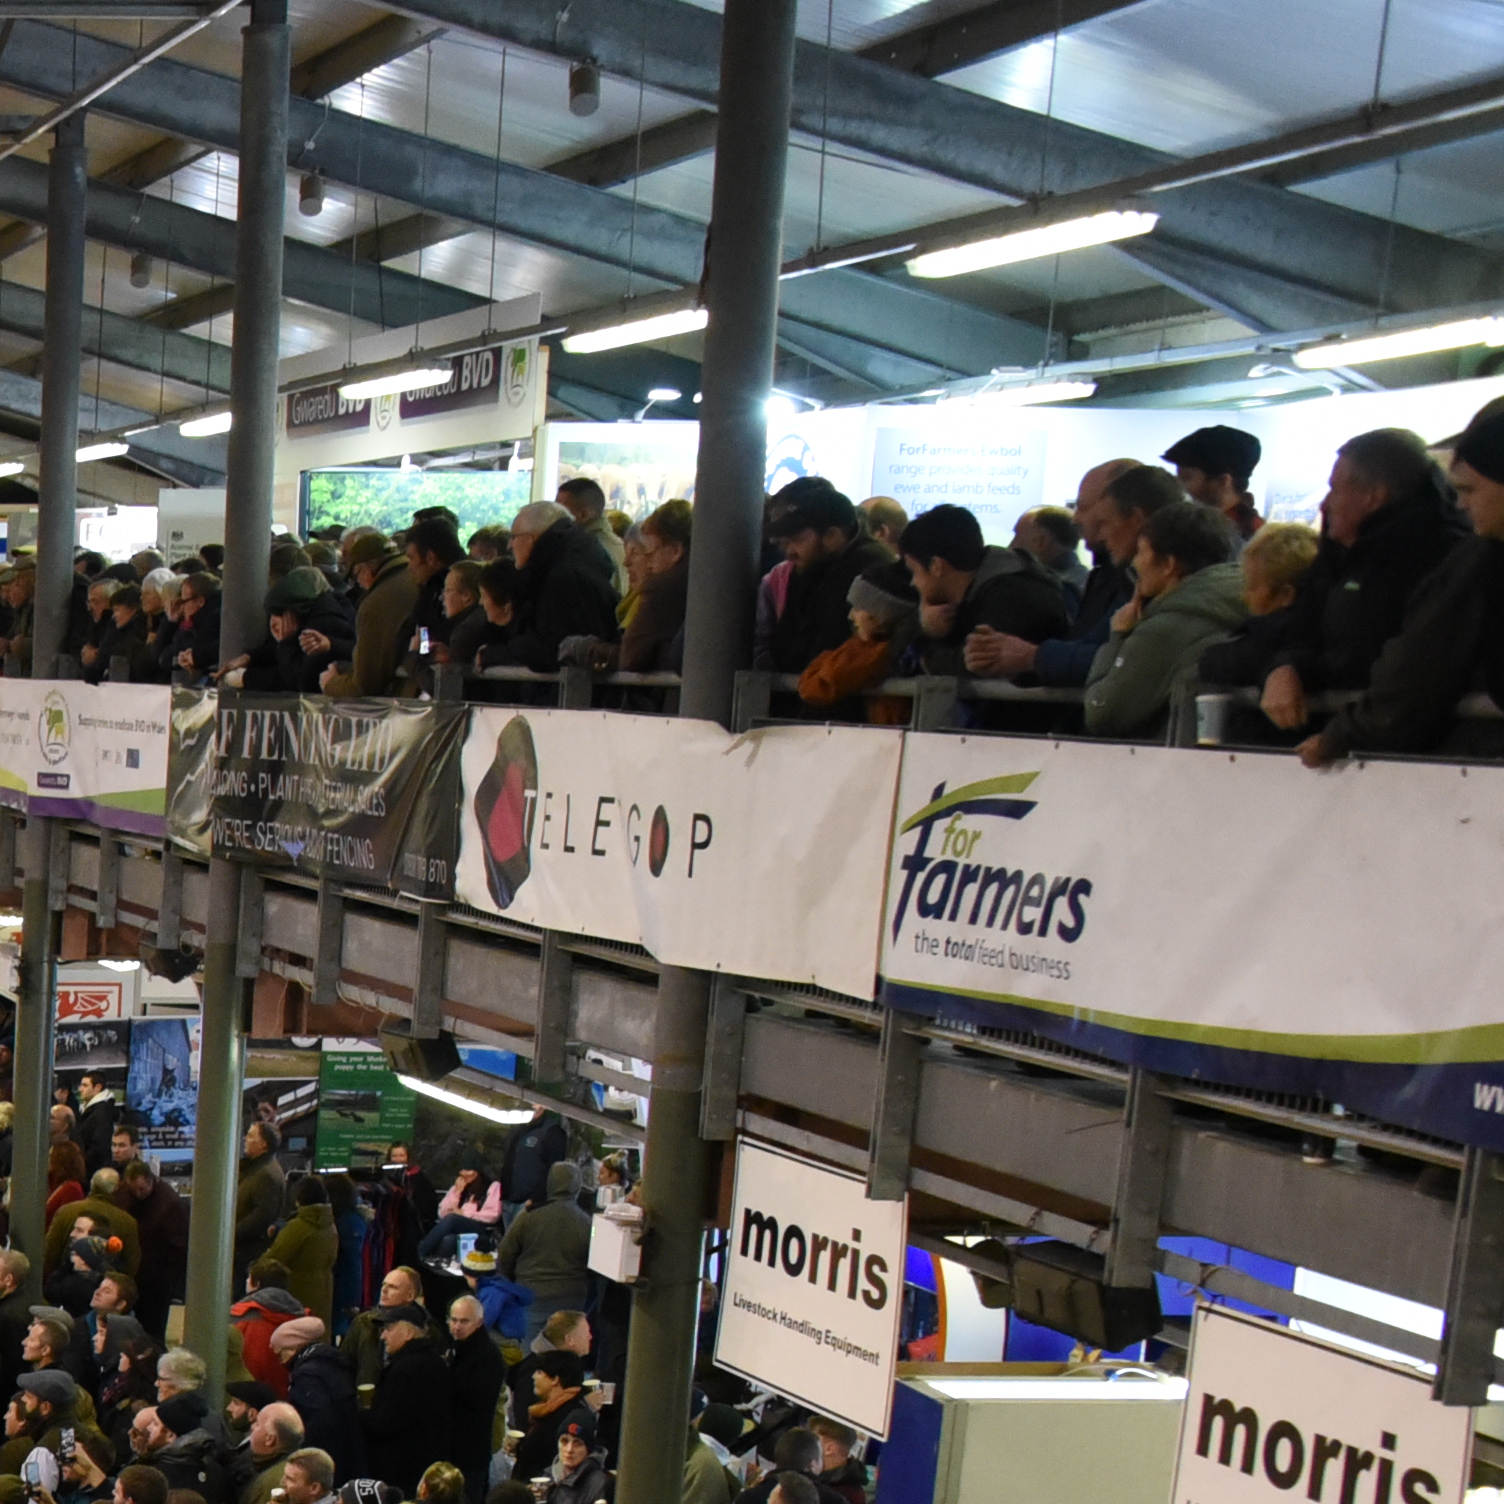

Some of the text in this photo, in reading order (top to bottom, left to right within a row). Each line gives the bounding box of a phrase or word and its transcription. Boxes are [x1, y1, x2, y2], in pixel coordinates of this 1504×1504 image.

[460, 350, 494, 391] BVD
[292, 393, 335, 425] Gwaredu
[888, 463, 1030, 479] range provides quality
[980, 444, 1022, 457] Ewbol
[893, 482, 1021, 495] ewe and lamb feeds
[910, 500, 928, 514] for
[241, 709, 342, 768] FENCING
[345, 716, 391, 773] LTD
[940, 813, 982, 860] for
[893, 812, 1093, 948] farmers
[914, 929, 940, 956] the
[1009, 945, 1071, 981] business
[326, 1055, 348, 1064] Giving
[739, 1206, 890, 1311] morris
[733, 1290, 880, 1367] Livestock Handling Equipment
